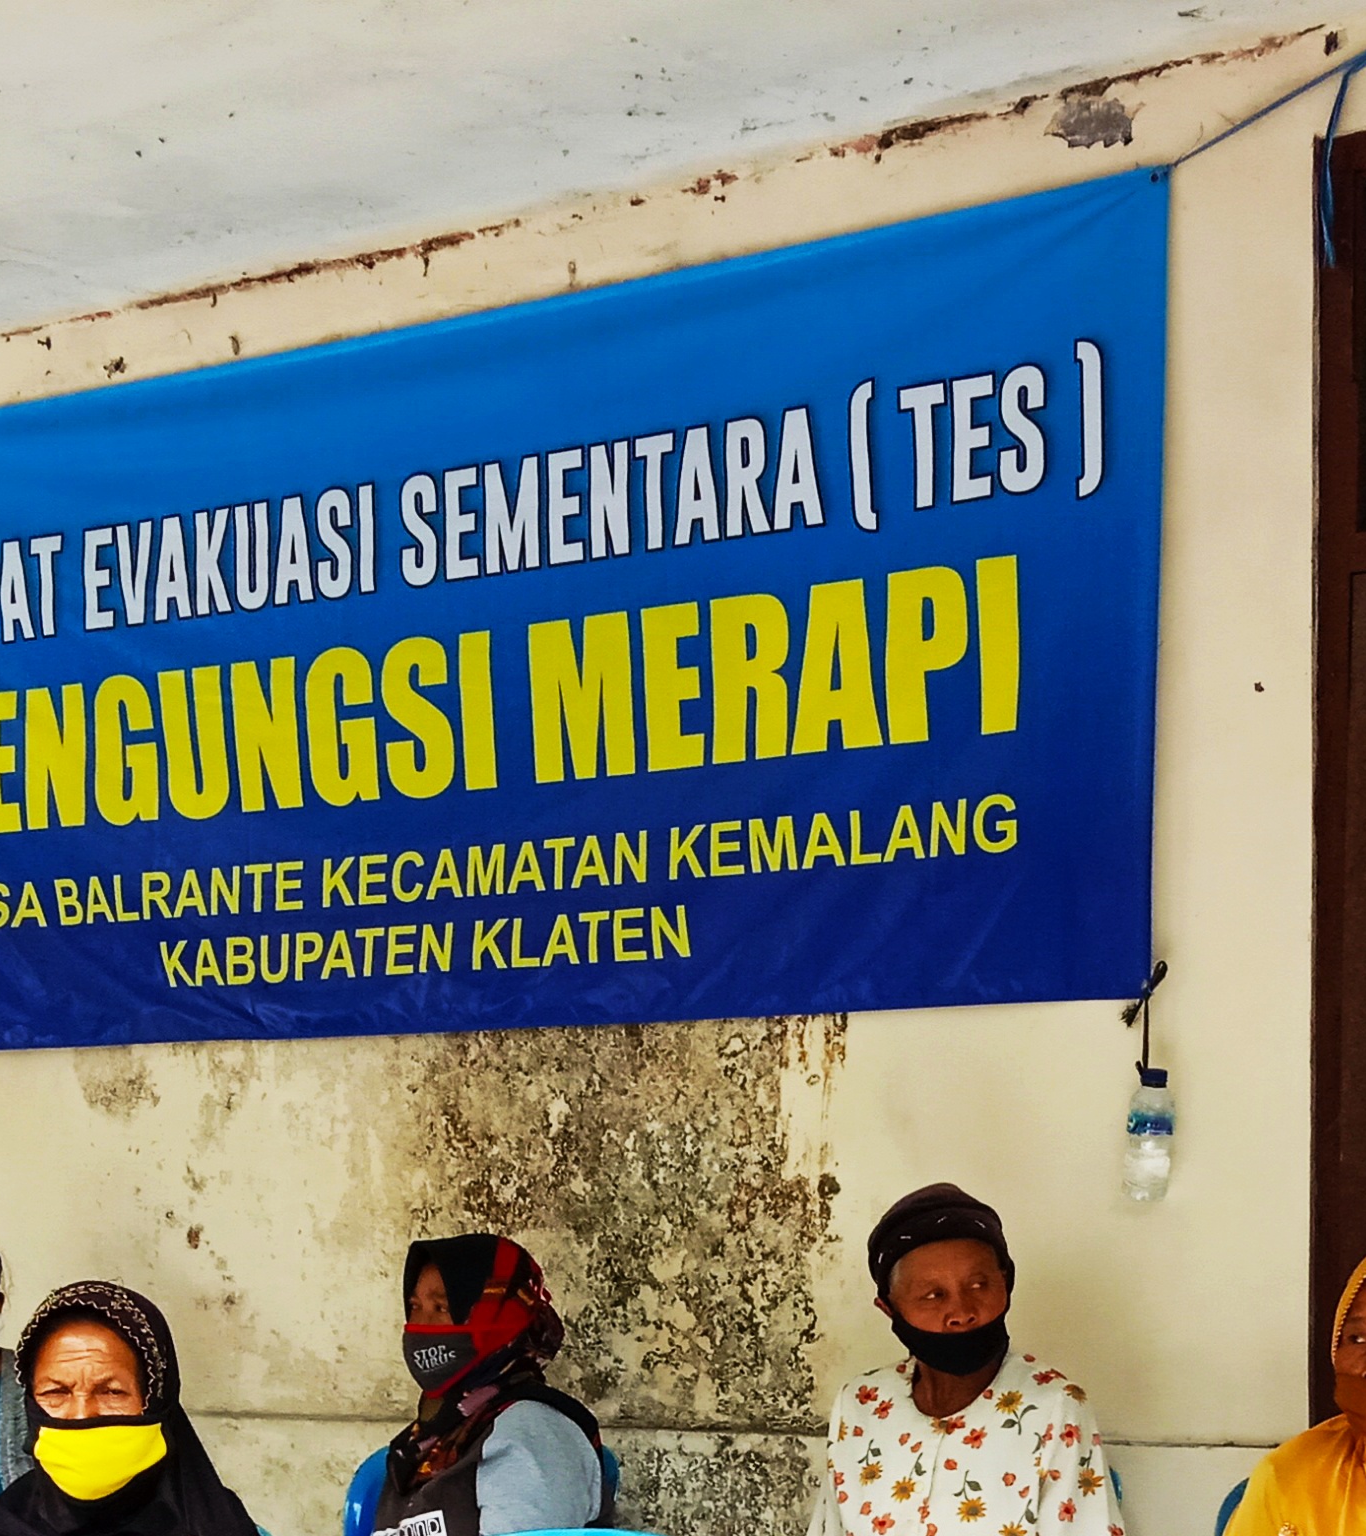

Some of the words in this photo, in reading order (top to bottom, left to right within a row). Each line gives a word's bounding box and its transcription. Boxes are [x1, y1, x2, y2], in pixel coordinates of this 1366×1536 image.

[82, 483, 376, 632] EVAKUASI
[400, 405, 826, 588] SEMENTARA
[899, 364, 1047, 511] TES
[527, 554, 1020, 784] MERAPI
[58, 860, 304, 926] BALRANTE
[321, 830, 649, 908] KECAMATAN
[668, 793, 1018, 882] KEMALANG
[159, 922, 454, 988] KABUPATEN
[471, 904, 692, 970] KLATEN
[413, 1345, 446, 1360] STOP
[414, 1351, 456, 1369] VIRUS
